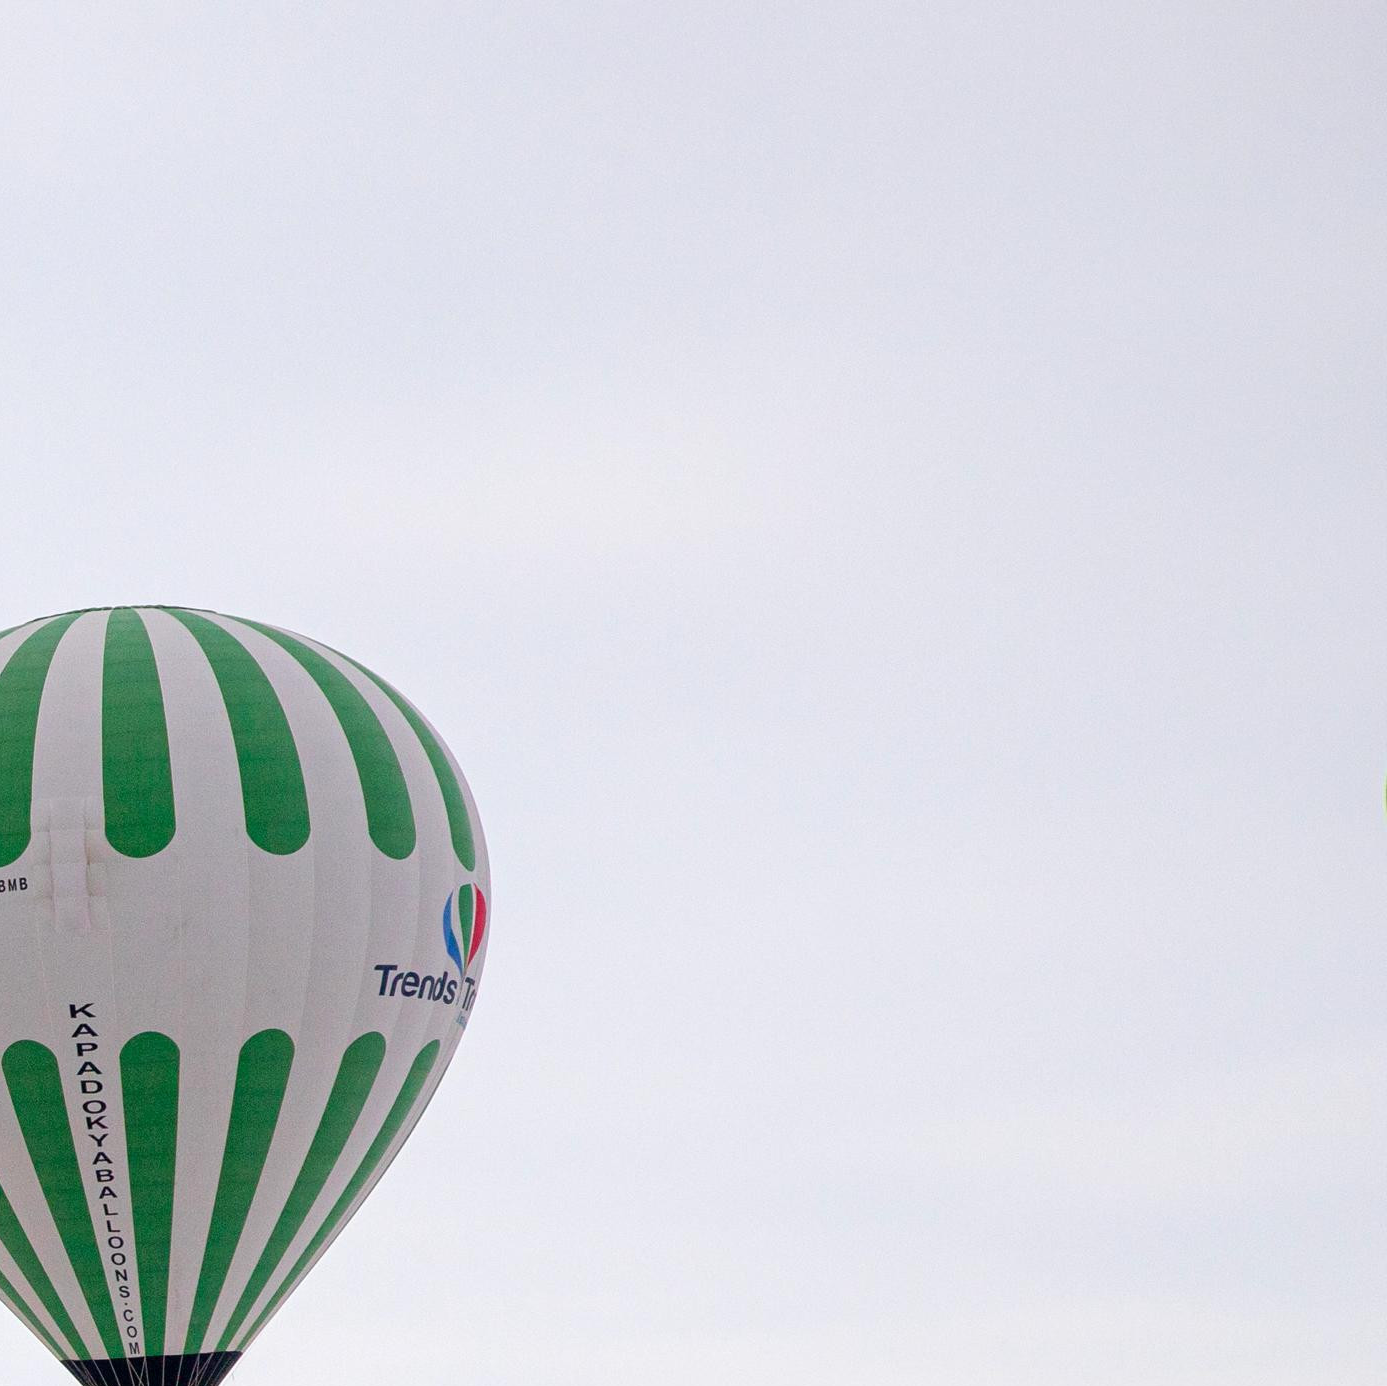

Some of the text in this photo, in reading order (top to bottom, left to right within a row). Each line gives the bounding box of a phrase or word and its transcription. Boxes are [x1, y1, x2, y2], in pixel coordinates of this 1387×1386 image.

[374, 964, 477, 1011] Trends Tr
[68, 1002, 141, 1356] KAPADOKYABALLOONS.COM
